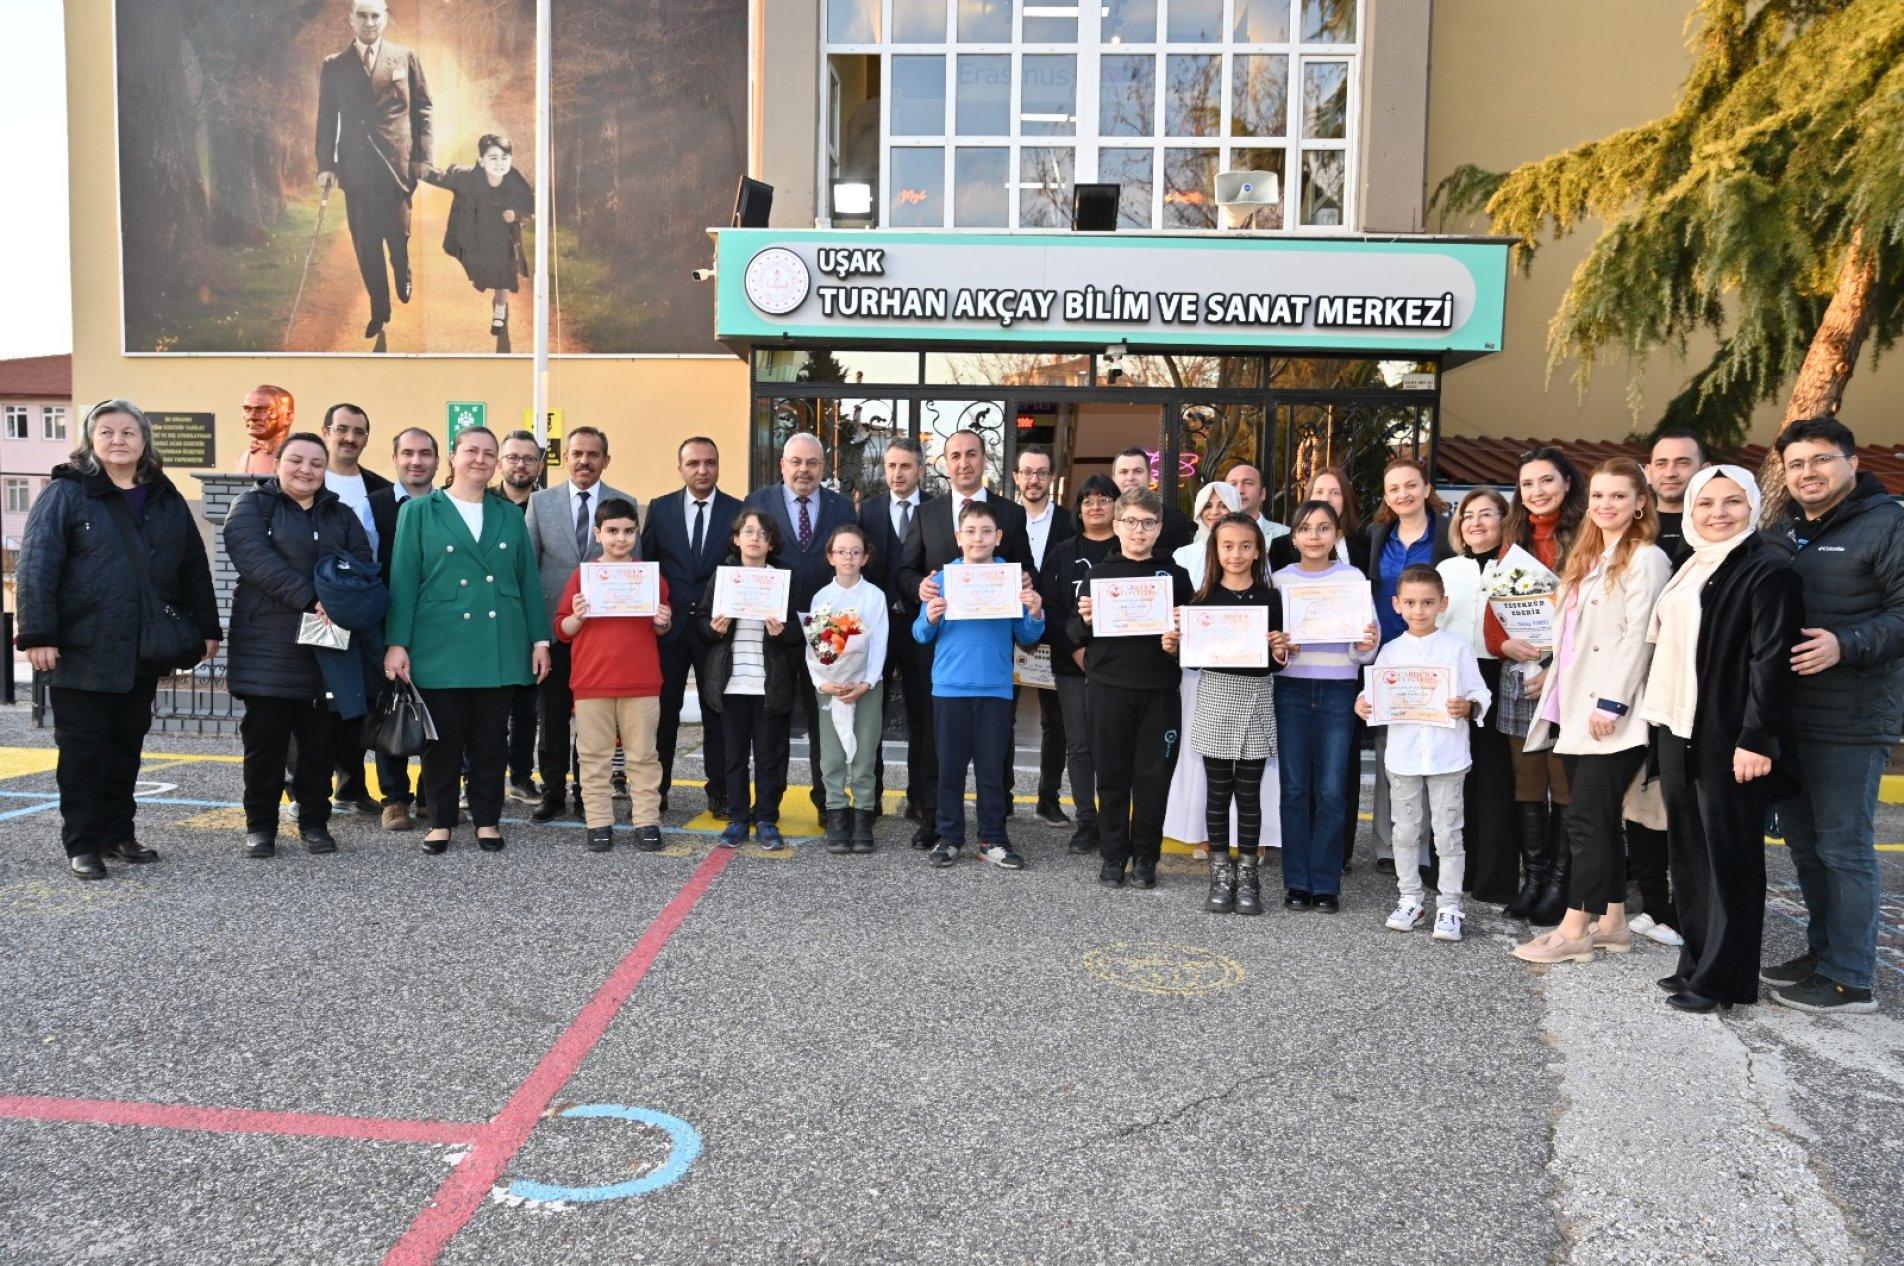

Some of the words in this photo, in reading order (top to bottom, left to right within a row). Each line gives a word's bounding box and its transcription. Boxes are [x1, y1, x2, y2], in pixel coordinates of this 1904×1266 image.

[818, 248, 884, 279] UŞAK
[818, 287, 946, 317] TURHAN
[953, 289, 1057, 326] AKÇAY
[1064, 285, 1150, 322] BİLİM
[1158, 293, 1198, 321] VE
[1206, 294, 1310, 325] SANAT
[1316, 293, 1453, 328] MERKEZİ
